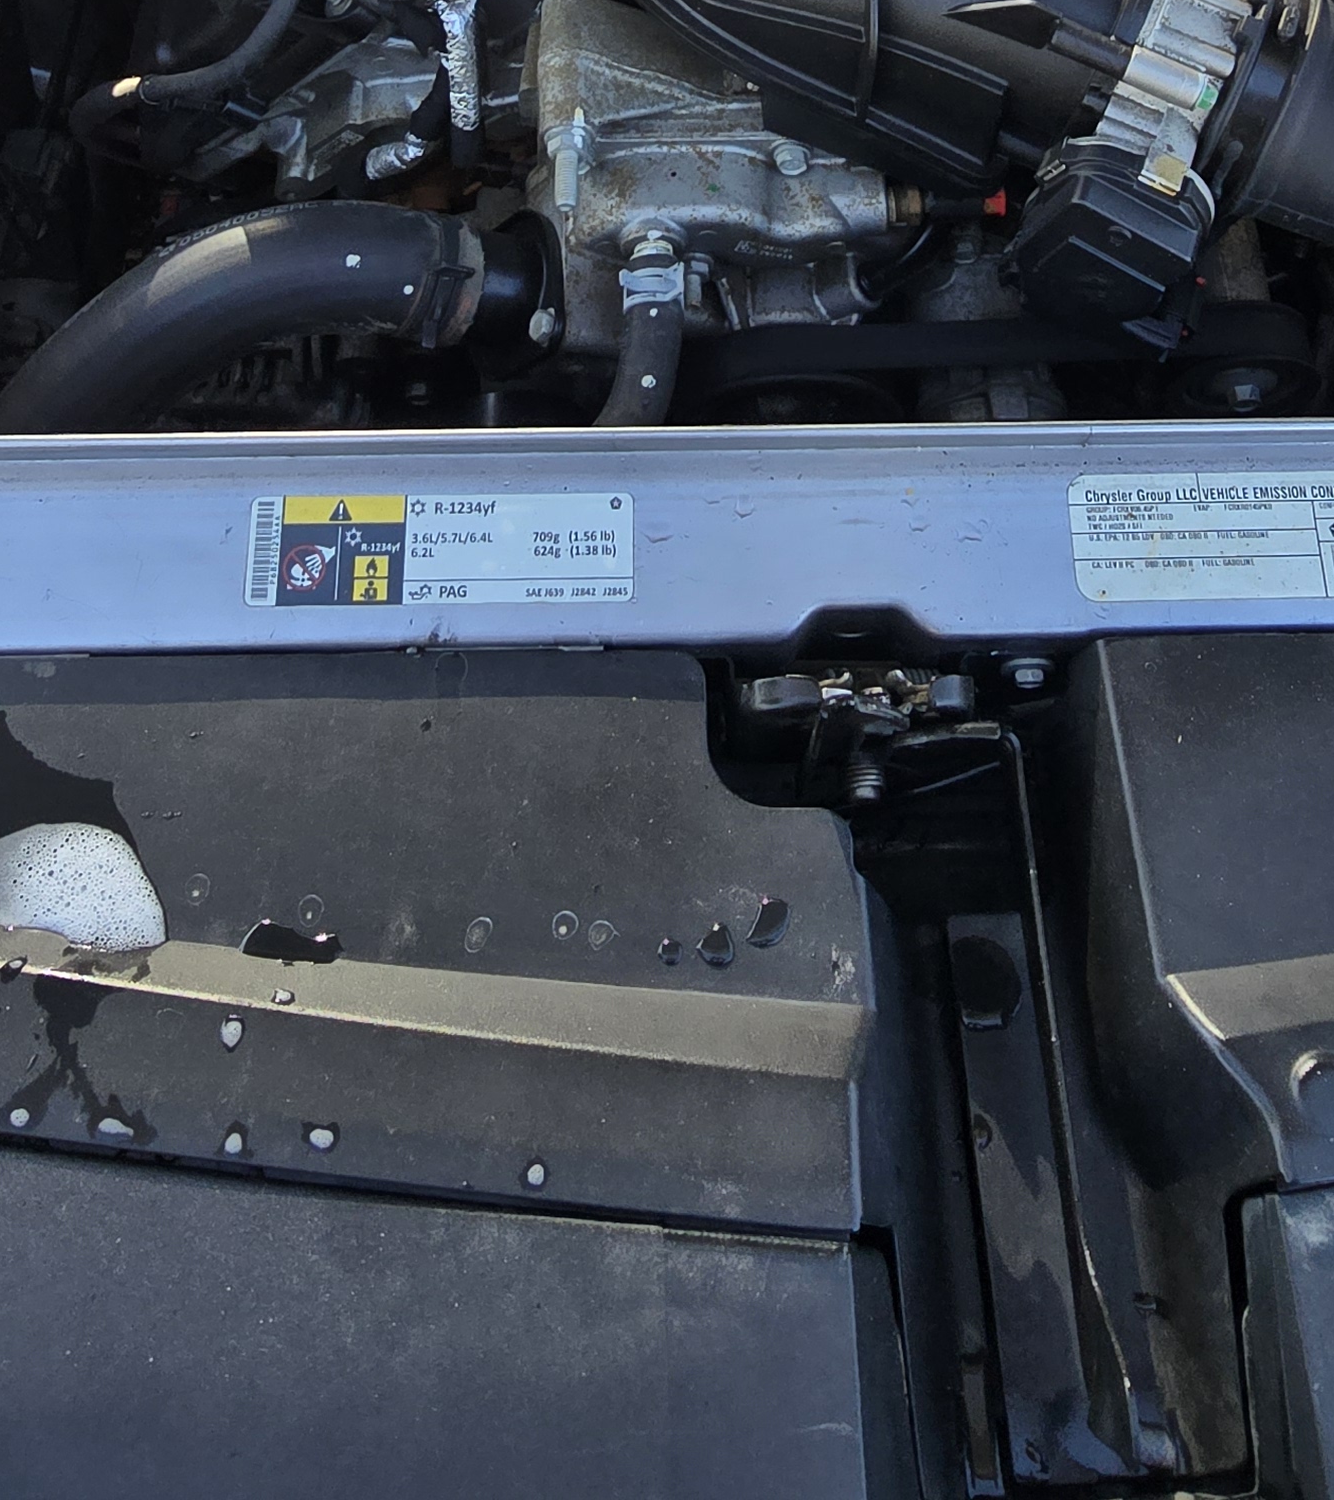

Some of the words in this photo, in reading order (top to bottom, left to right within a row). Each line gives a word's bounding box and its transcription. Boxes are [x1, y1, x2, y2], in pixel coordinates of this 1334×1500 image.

[1085, 489, 1132, 504] Chrysler
[1136, 488, 1171, 503] Group
[1175, 487, 1197, 501] LLC
[1201, 486, 1249, 500] VEHICLE
[1253, 485, 1307, 499] EMISSION
[434, 500, 496, 517] R-1234yf
[411, 531, 494, 546] 3.6L/5.7L/6.4L
[533, 531, 560, 544] 709g
[569, 530, 597, 543] (1.56
[600, 530, 615, 543] lb)
[361, 542, 400, 553] R-1234yf
[411, 547, 435, 558] 6.2L
[534, 546, 561, 558] 624g
[570, 545, 599, 558] (1.38
[601, 544, 617, 558] lb)
[439, 585, 467, 598] PAG
[525, 587, 542, 597] SAE
[544, 587, 565, 597] J639
